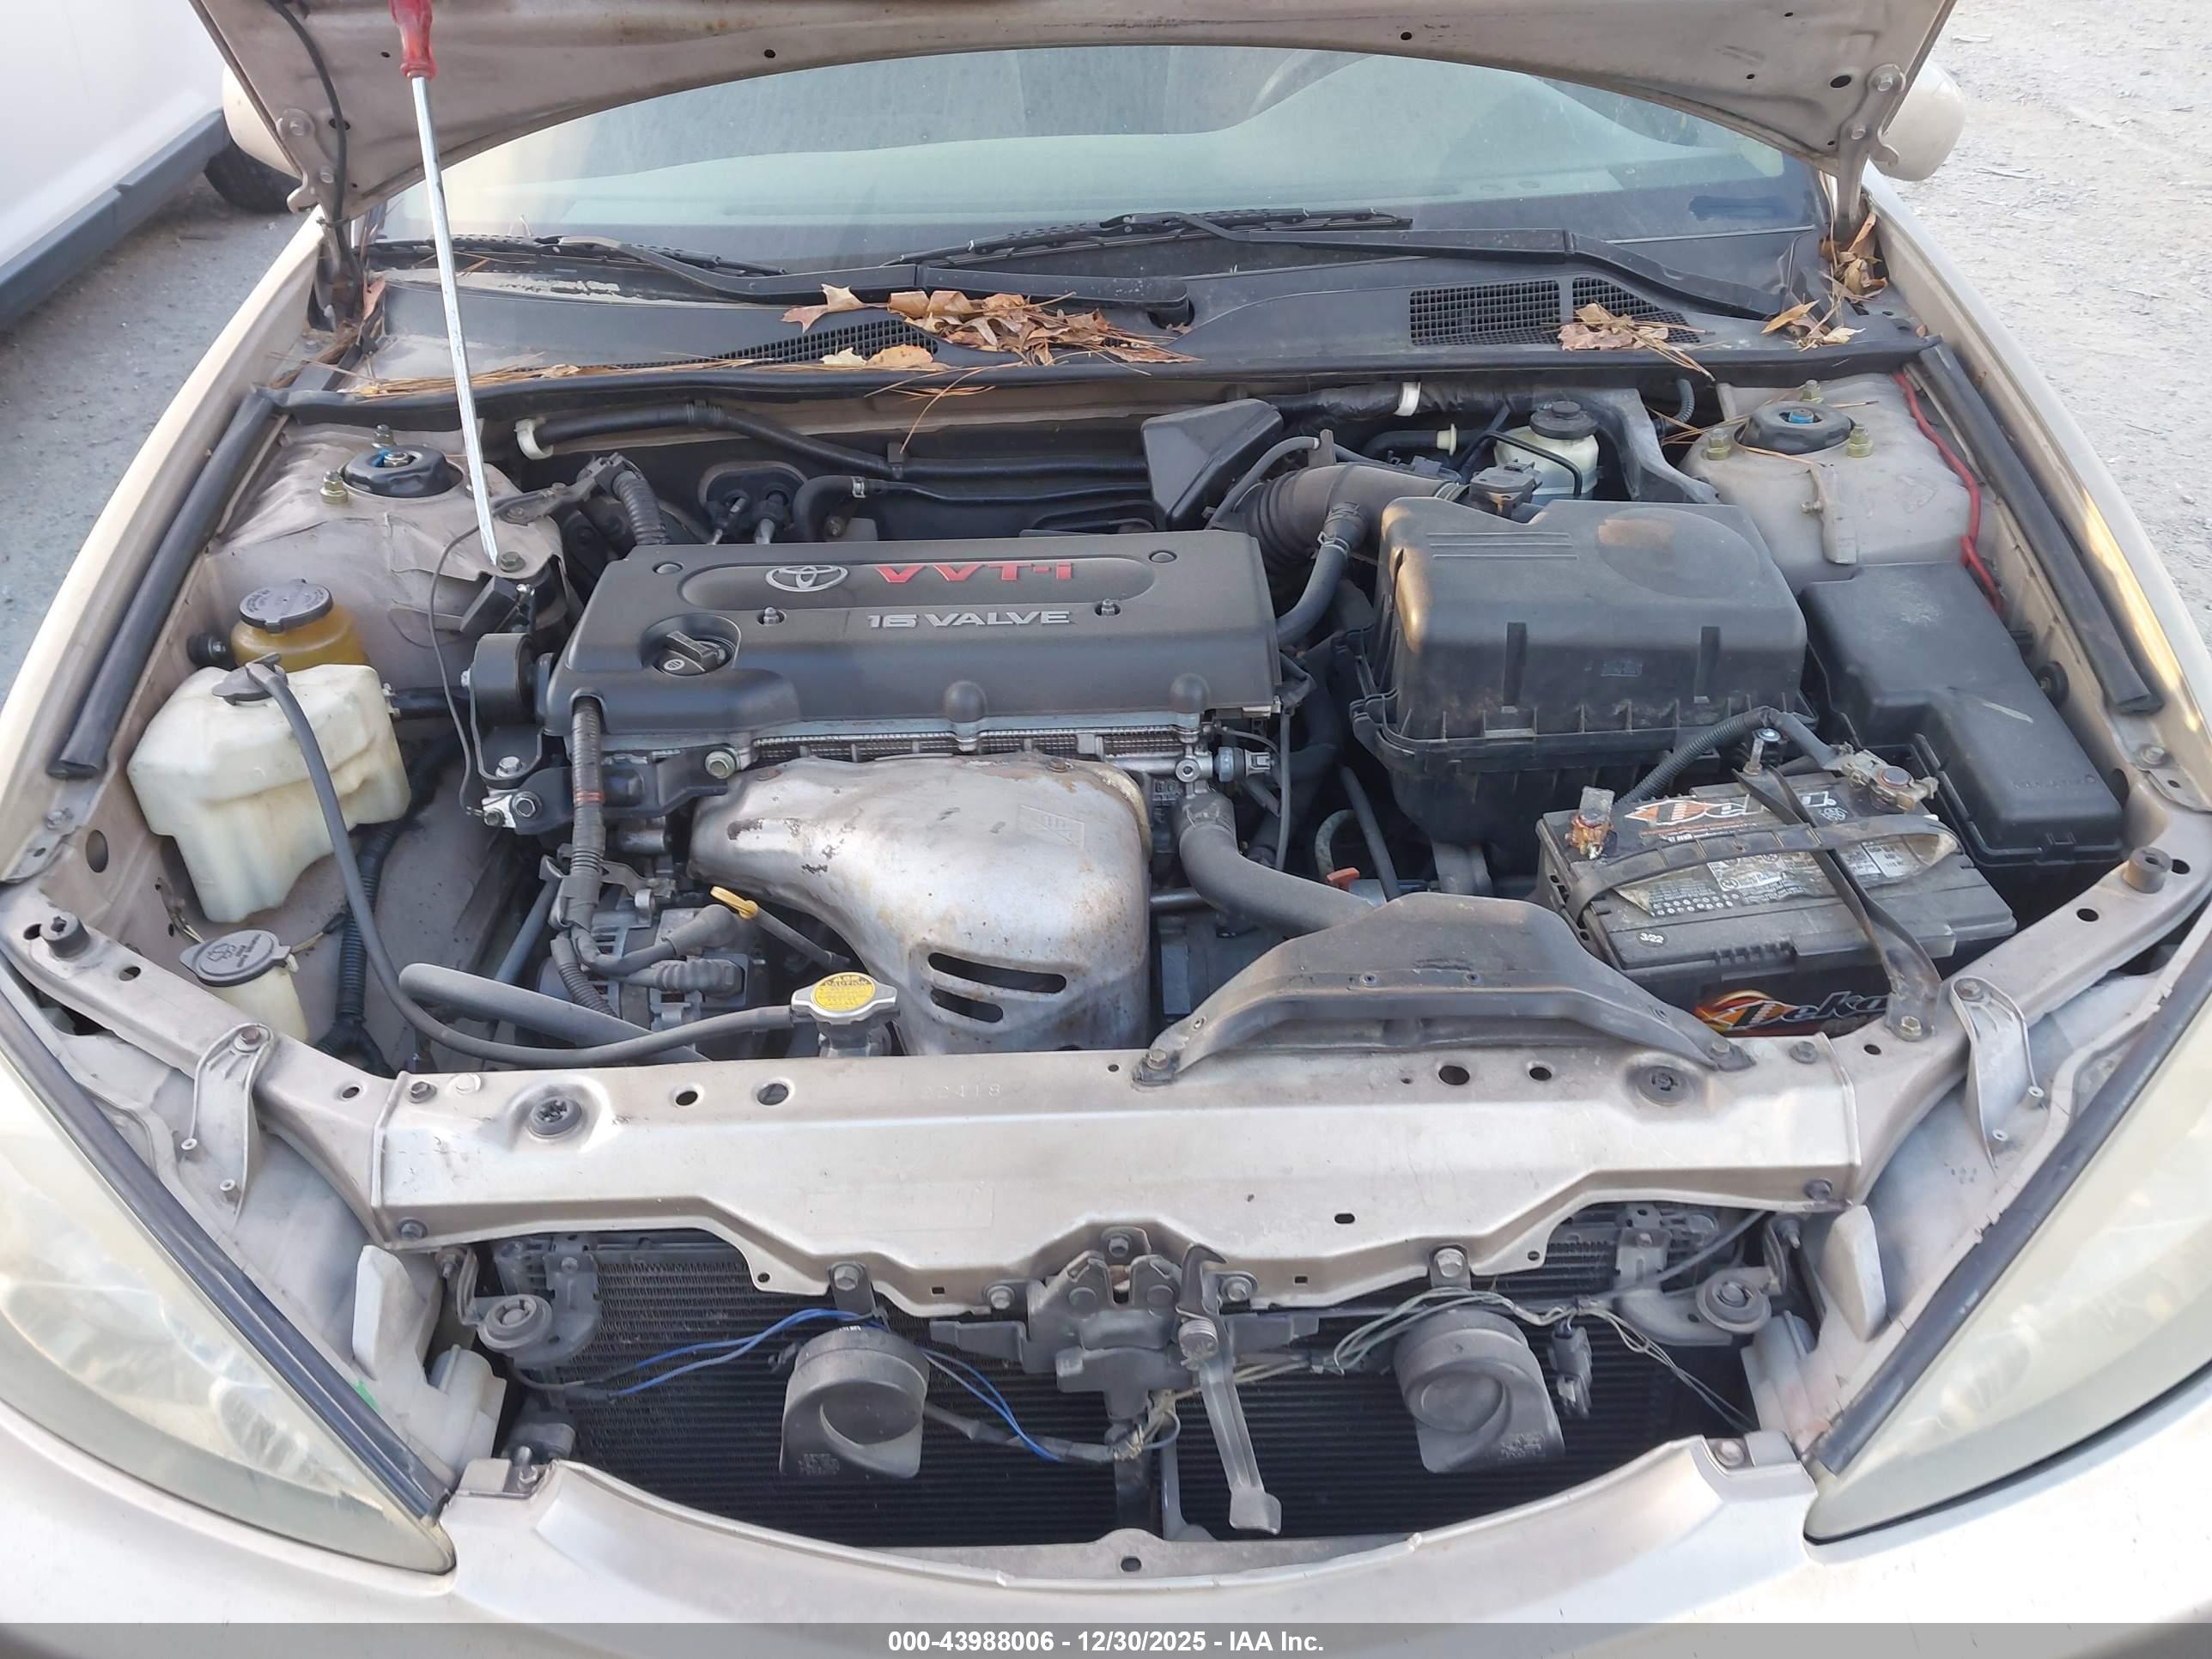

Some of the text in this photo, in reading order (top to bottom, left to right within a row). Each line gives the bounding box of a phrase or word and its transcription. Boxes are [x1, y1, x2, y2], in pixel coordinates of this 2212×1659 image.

[873, 562, 1073, 583] VVT-i
[867, 611, 1072, 629] 16 VALVE
